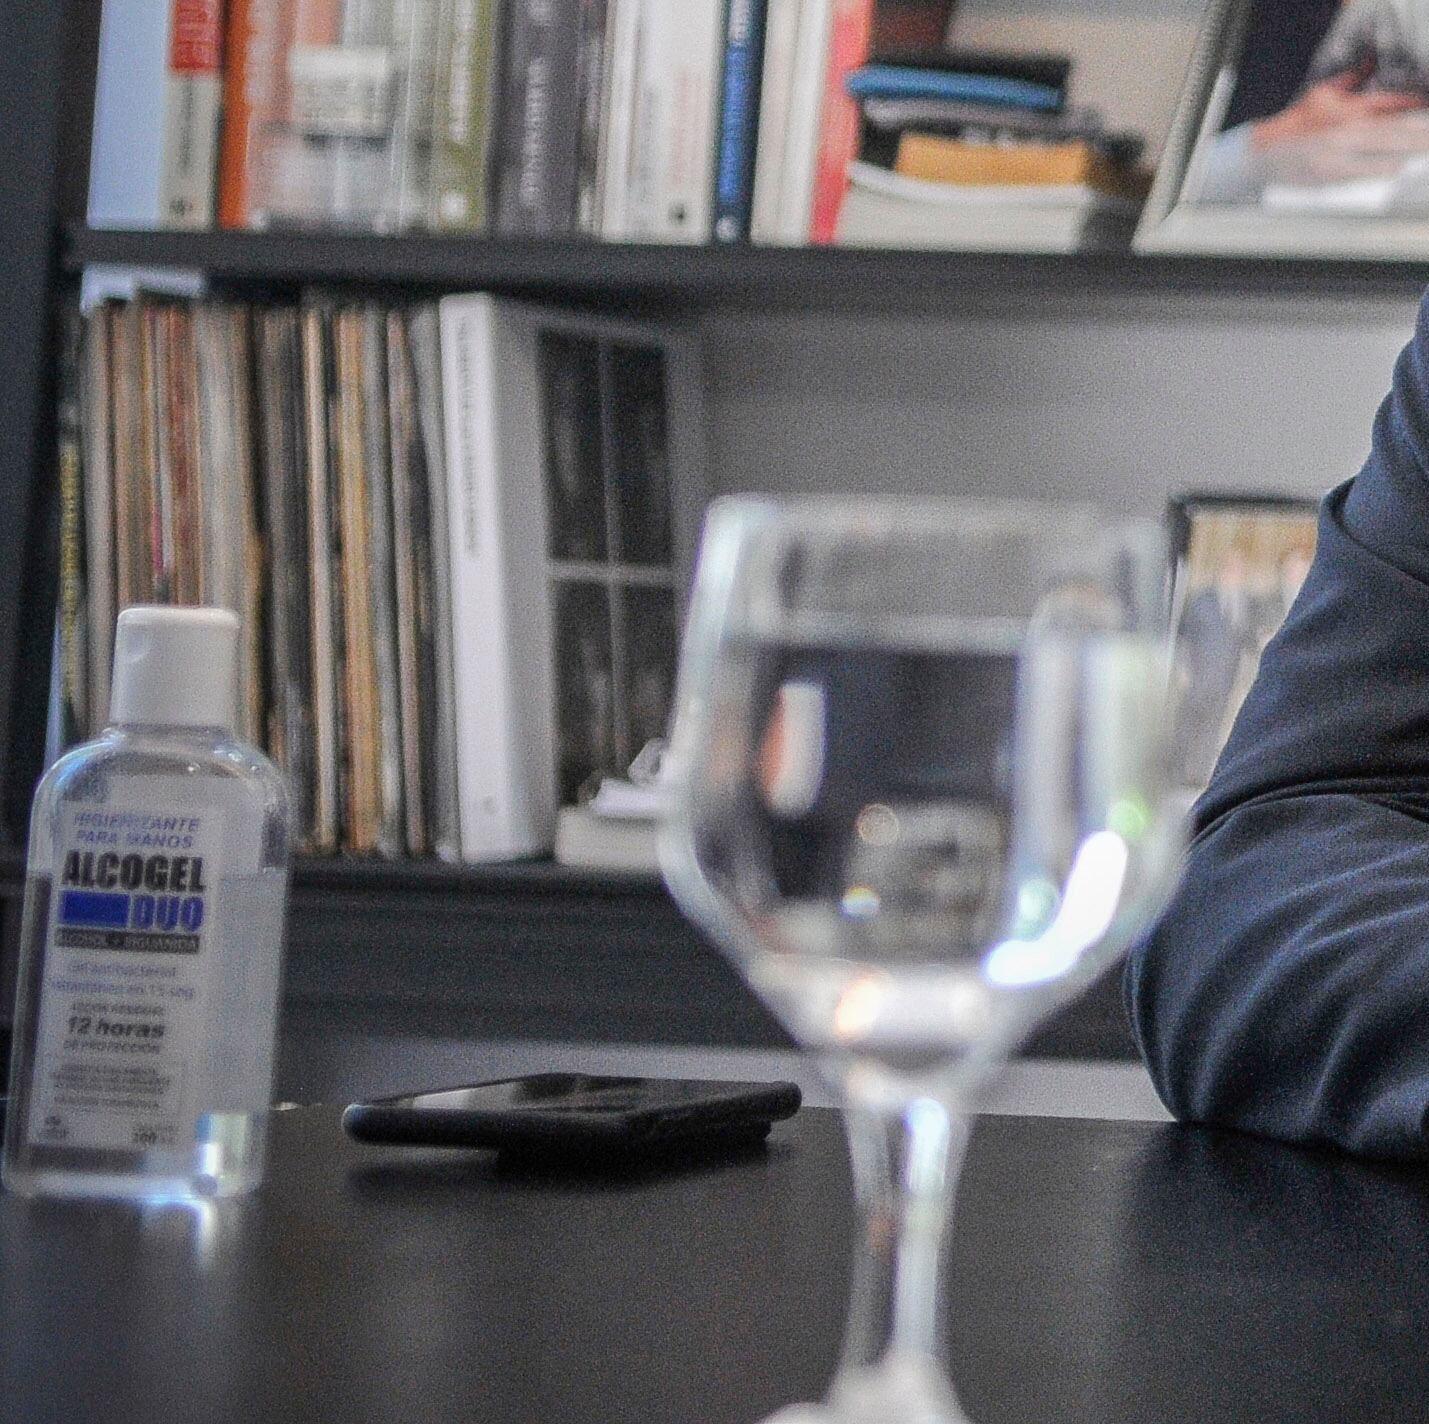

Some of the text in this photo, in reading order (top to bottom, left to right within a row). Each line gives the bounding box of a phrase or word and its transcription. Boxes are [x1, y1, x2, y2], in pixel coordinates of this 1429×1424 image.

[62, 850, 205, 893] ALCOGEL
[132, 894, 204, 933] DUO
[68, 1017, 167, 1039] 12 horas
